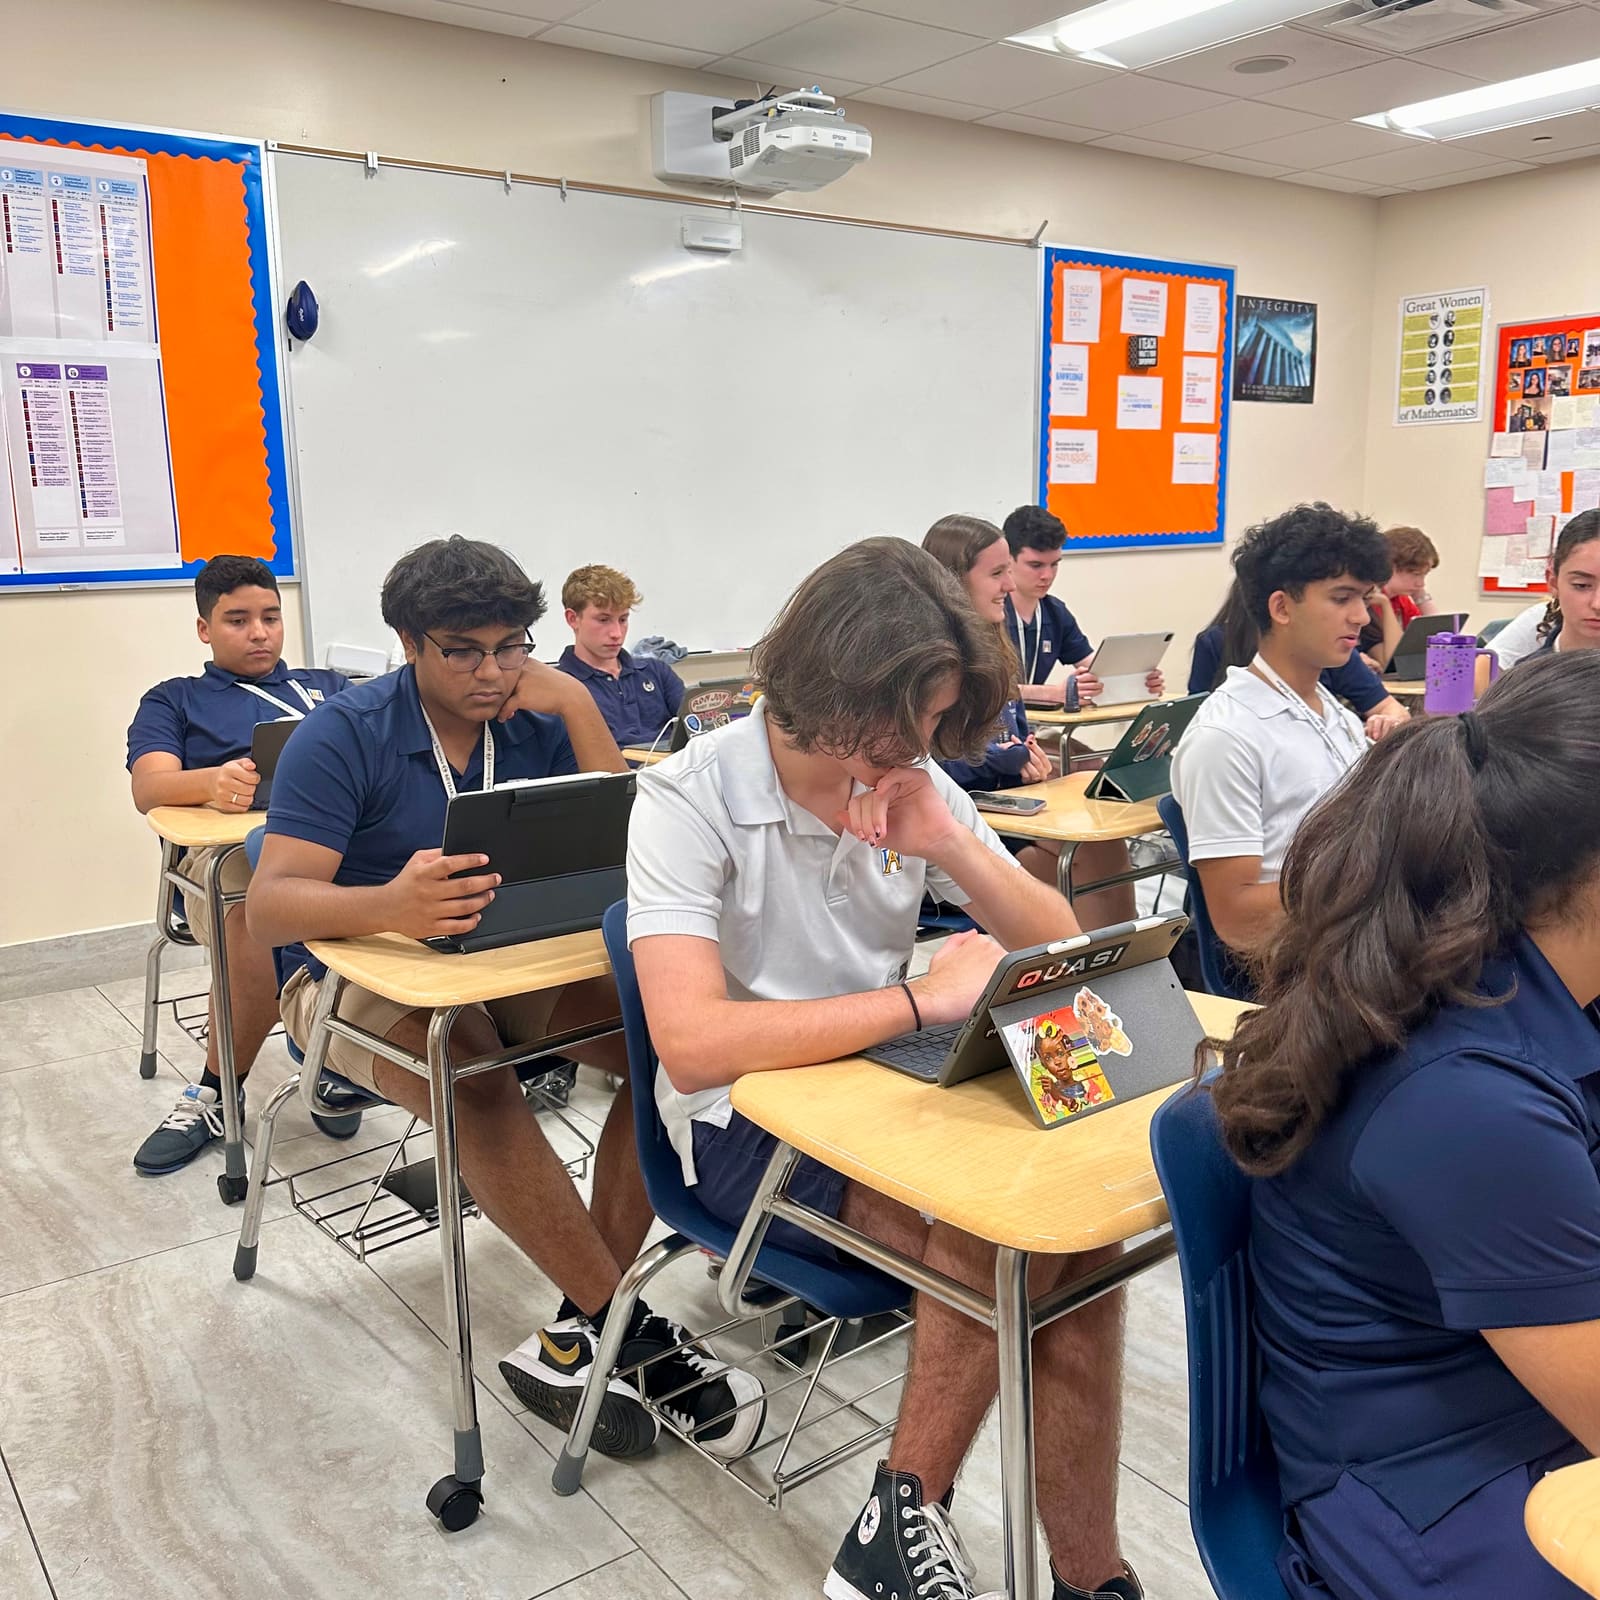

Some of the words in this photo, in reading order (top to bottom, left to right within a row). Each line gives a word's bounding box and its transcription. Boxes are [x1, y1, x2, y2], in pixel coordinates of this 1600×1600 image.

[1242, 298, 1312, 313] INTEGRITY
[1406, 301, 1436, 313] Great
[1439, 295, 1481, 308] Women
[1400, 410, 1412, 420] of
[1411, 405, 1476, 419] Mathematics
[1017, 946, 1124, 989] QUASI
